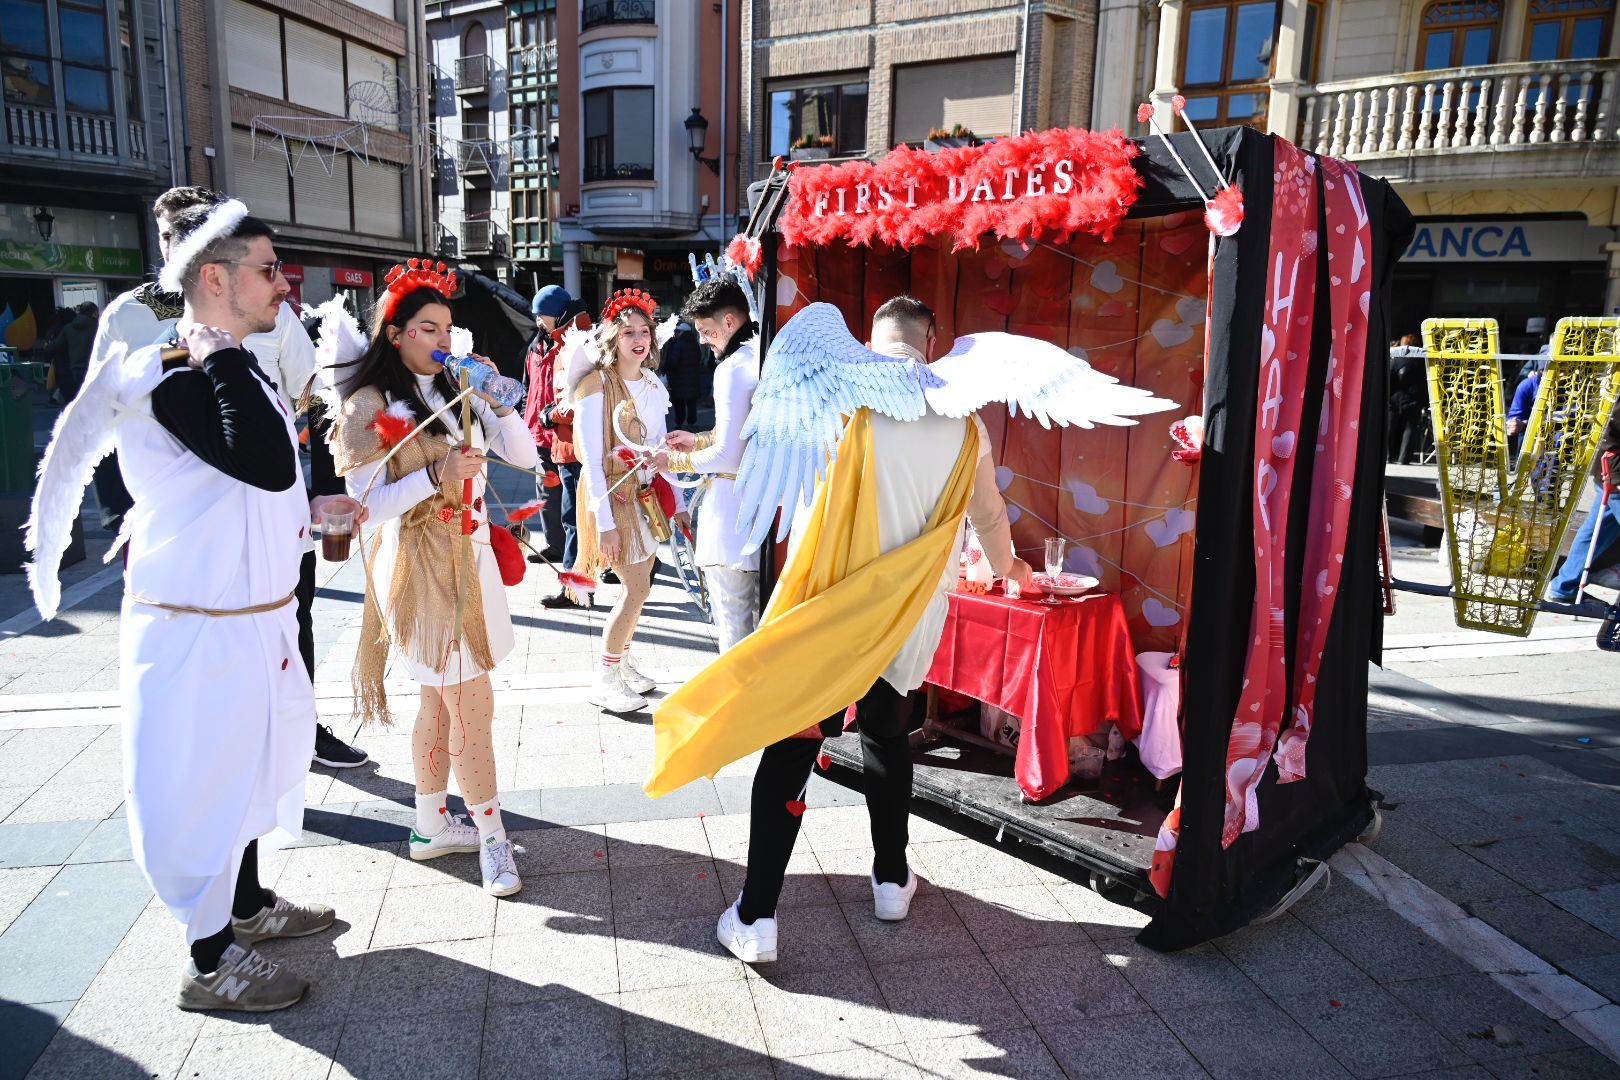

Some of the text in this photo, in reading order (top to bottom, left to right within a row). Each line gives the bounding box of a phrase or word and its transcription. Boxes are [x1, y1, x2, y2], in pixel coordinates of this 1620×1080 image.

[815, 159, 1074, 218] FIRST DATES
[1406, 226, 1531, 258] ANCA
[345, 271, 363, 284] GAES
